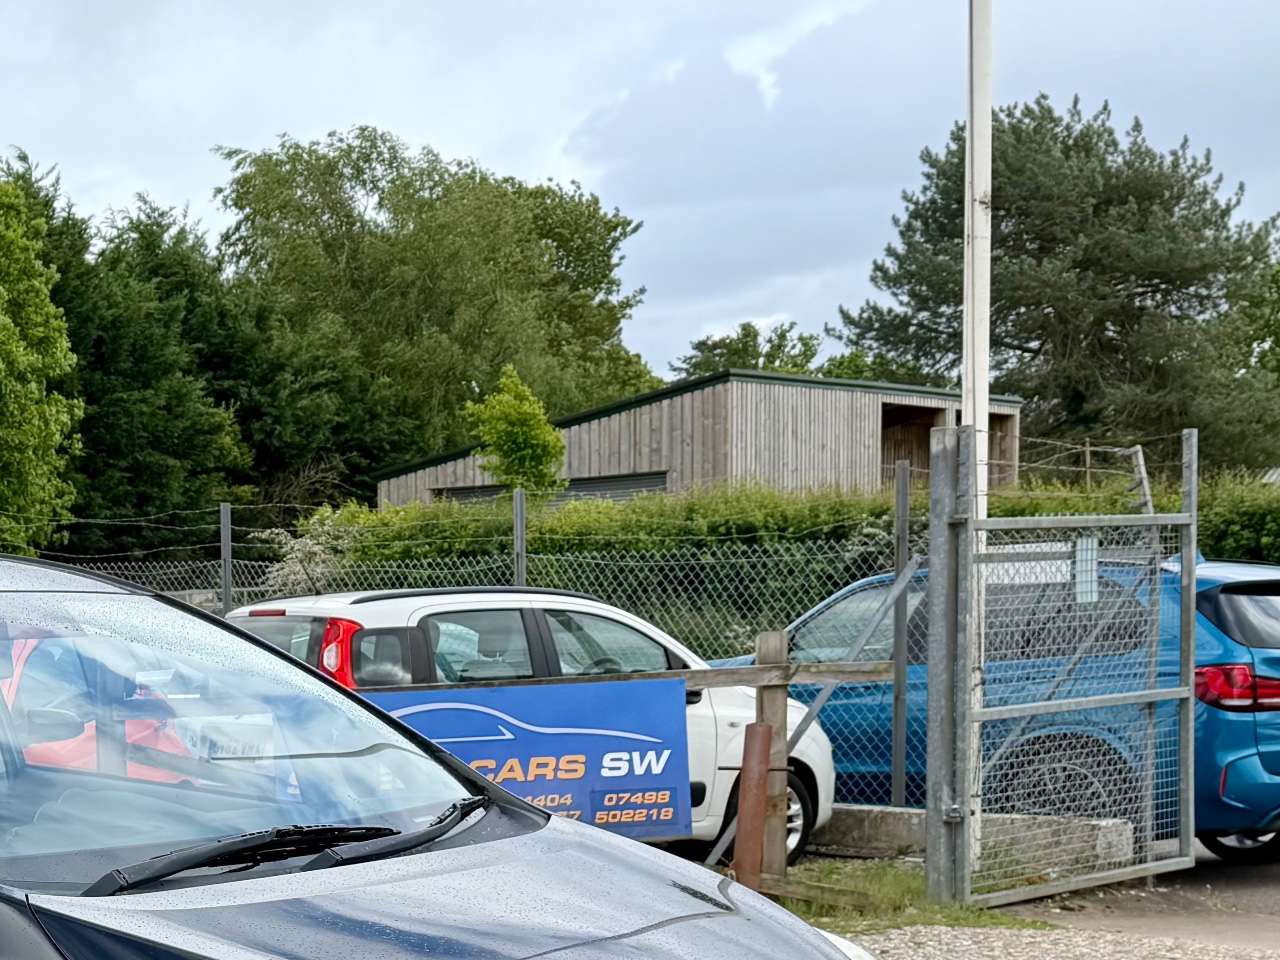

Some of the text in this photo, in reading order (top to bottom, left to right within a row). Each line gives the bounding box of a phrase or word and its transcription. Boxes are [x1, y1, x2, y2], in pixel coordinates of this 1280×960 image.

[470, 750, 672, 784] CARS SW
[604, 791, 671, 807] 07498
[595, 808, 674, 824] 502218
